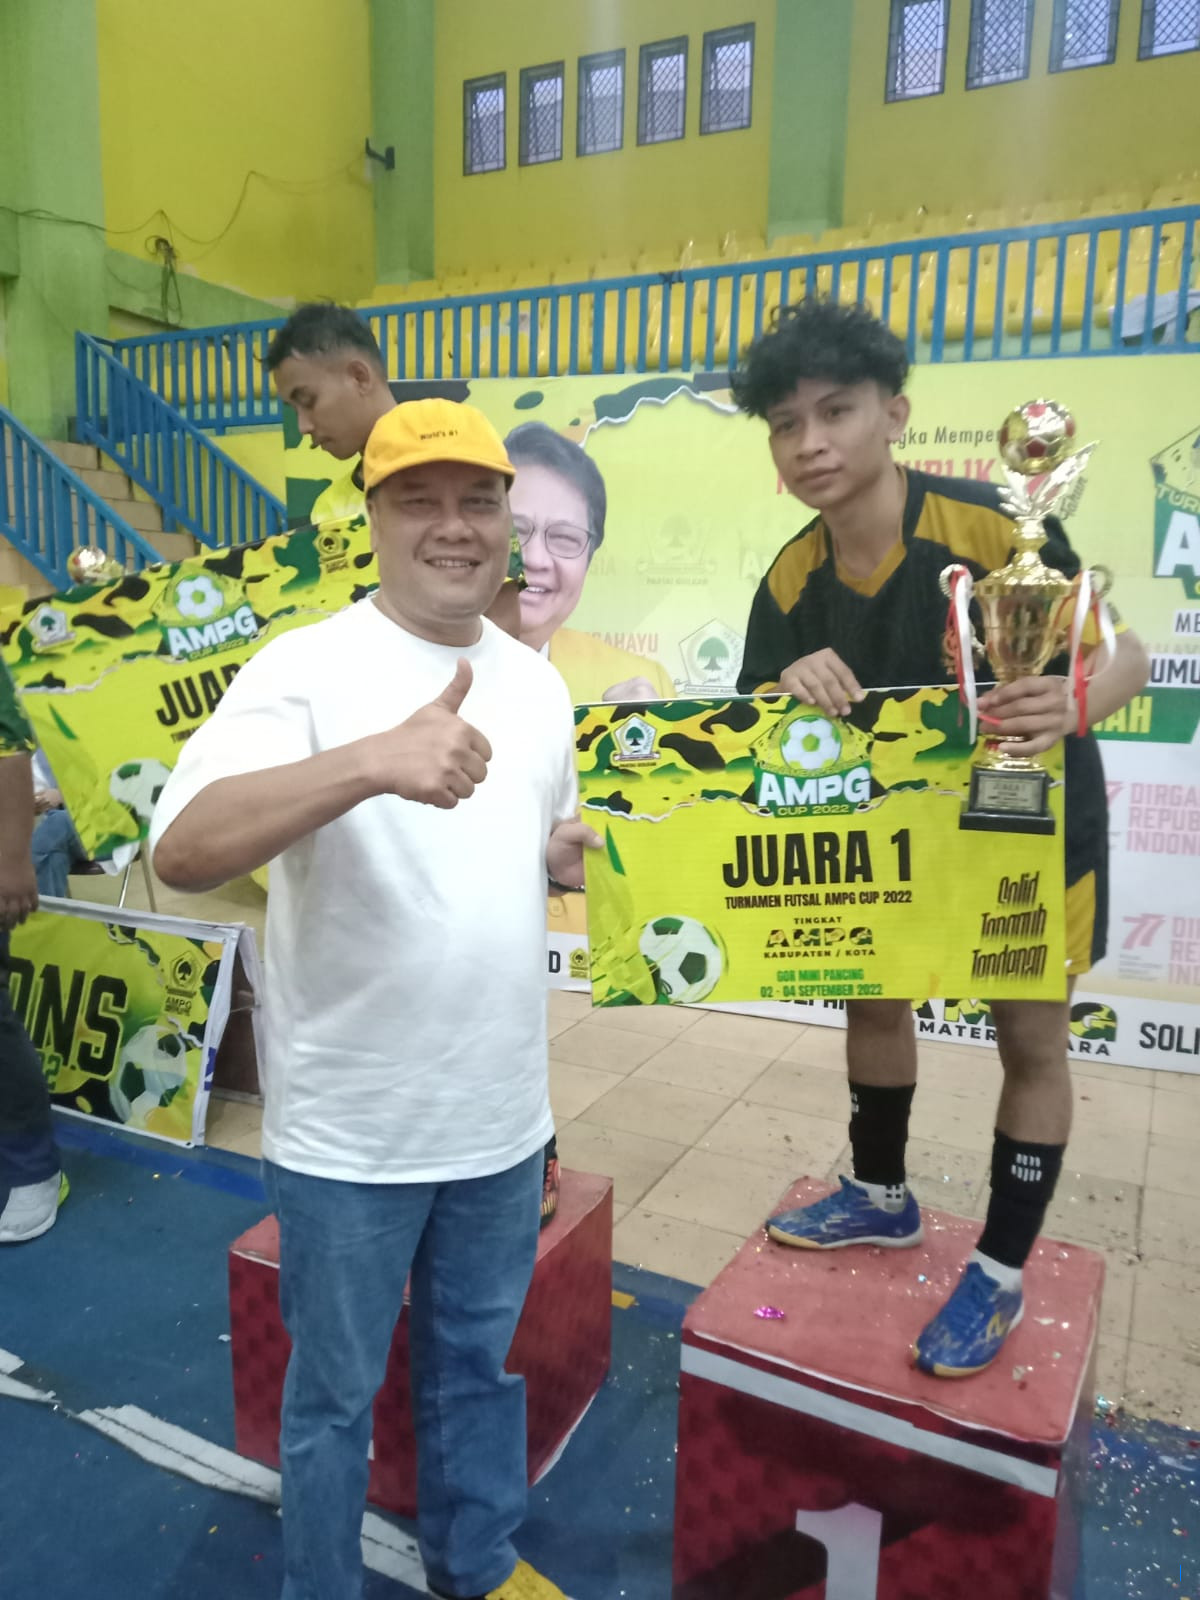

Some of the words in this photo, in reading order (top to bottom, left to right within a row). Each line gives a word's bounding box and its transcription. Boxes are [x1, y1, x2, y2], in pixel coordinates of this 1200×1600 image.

[893, 427, 927, 449] gka
[168, 606, 258, 656] AMPG
[1092, 696, 1152, 733] AH
[758, 766, 871, 807] AMPG
[777, 807, 808, 816] CUP
[812, 804, 849, 815] 2022
[722, 830, 873, 888] JUARA
[890, 828, 912, 882] 1
[725, 895, 782, 910] TURNAMEN
[784, 893, 821, 907] FUTSAL
[824, 892, 856, 906] AMPG
[859, 891, 880, 904] CUP
[883, 890, 912, 904] 2022
[793, 916, 843, 925] TINGKAT
[1122, 913, 1167, 950] 77
[766, 926, 874, 948] AMPG
[763, 950, 832, 959] KABUPATEN
[845, 949, 876, 957] KOTA
[760, 985, 774, 998] 02
[782, 985, 796, 997] 04
[798, 984, 854, 997] SEPTEMBER
[857, 983, 883, 996] 2022
